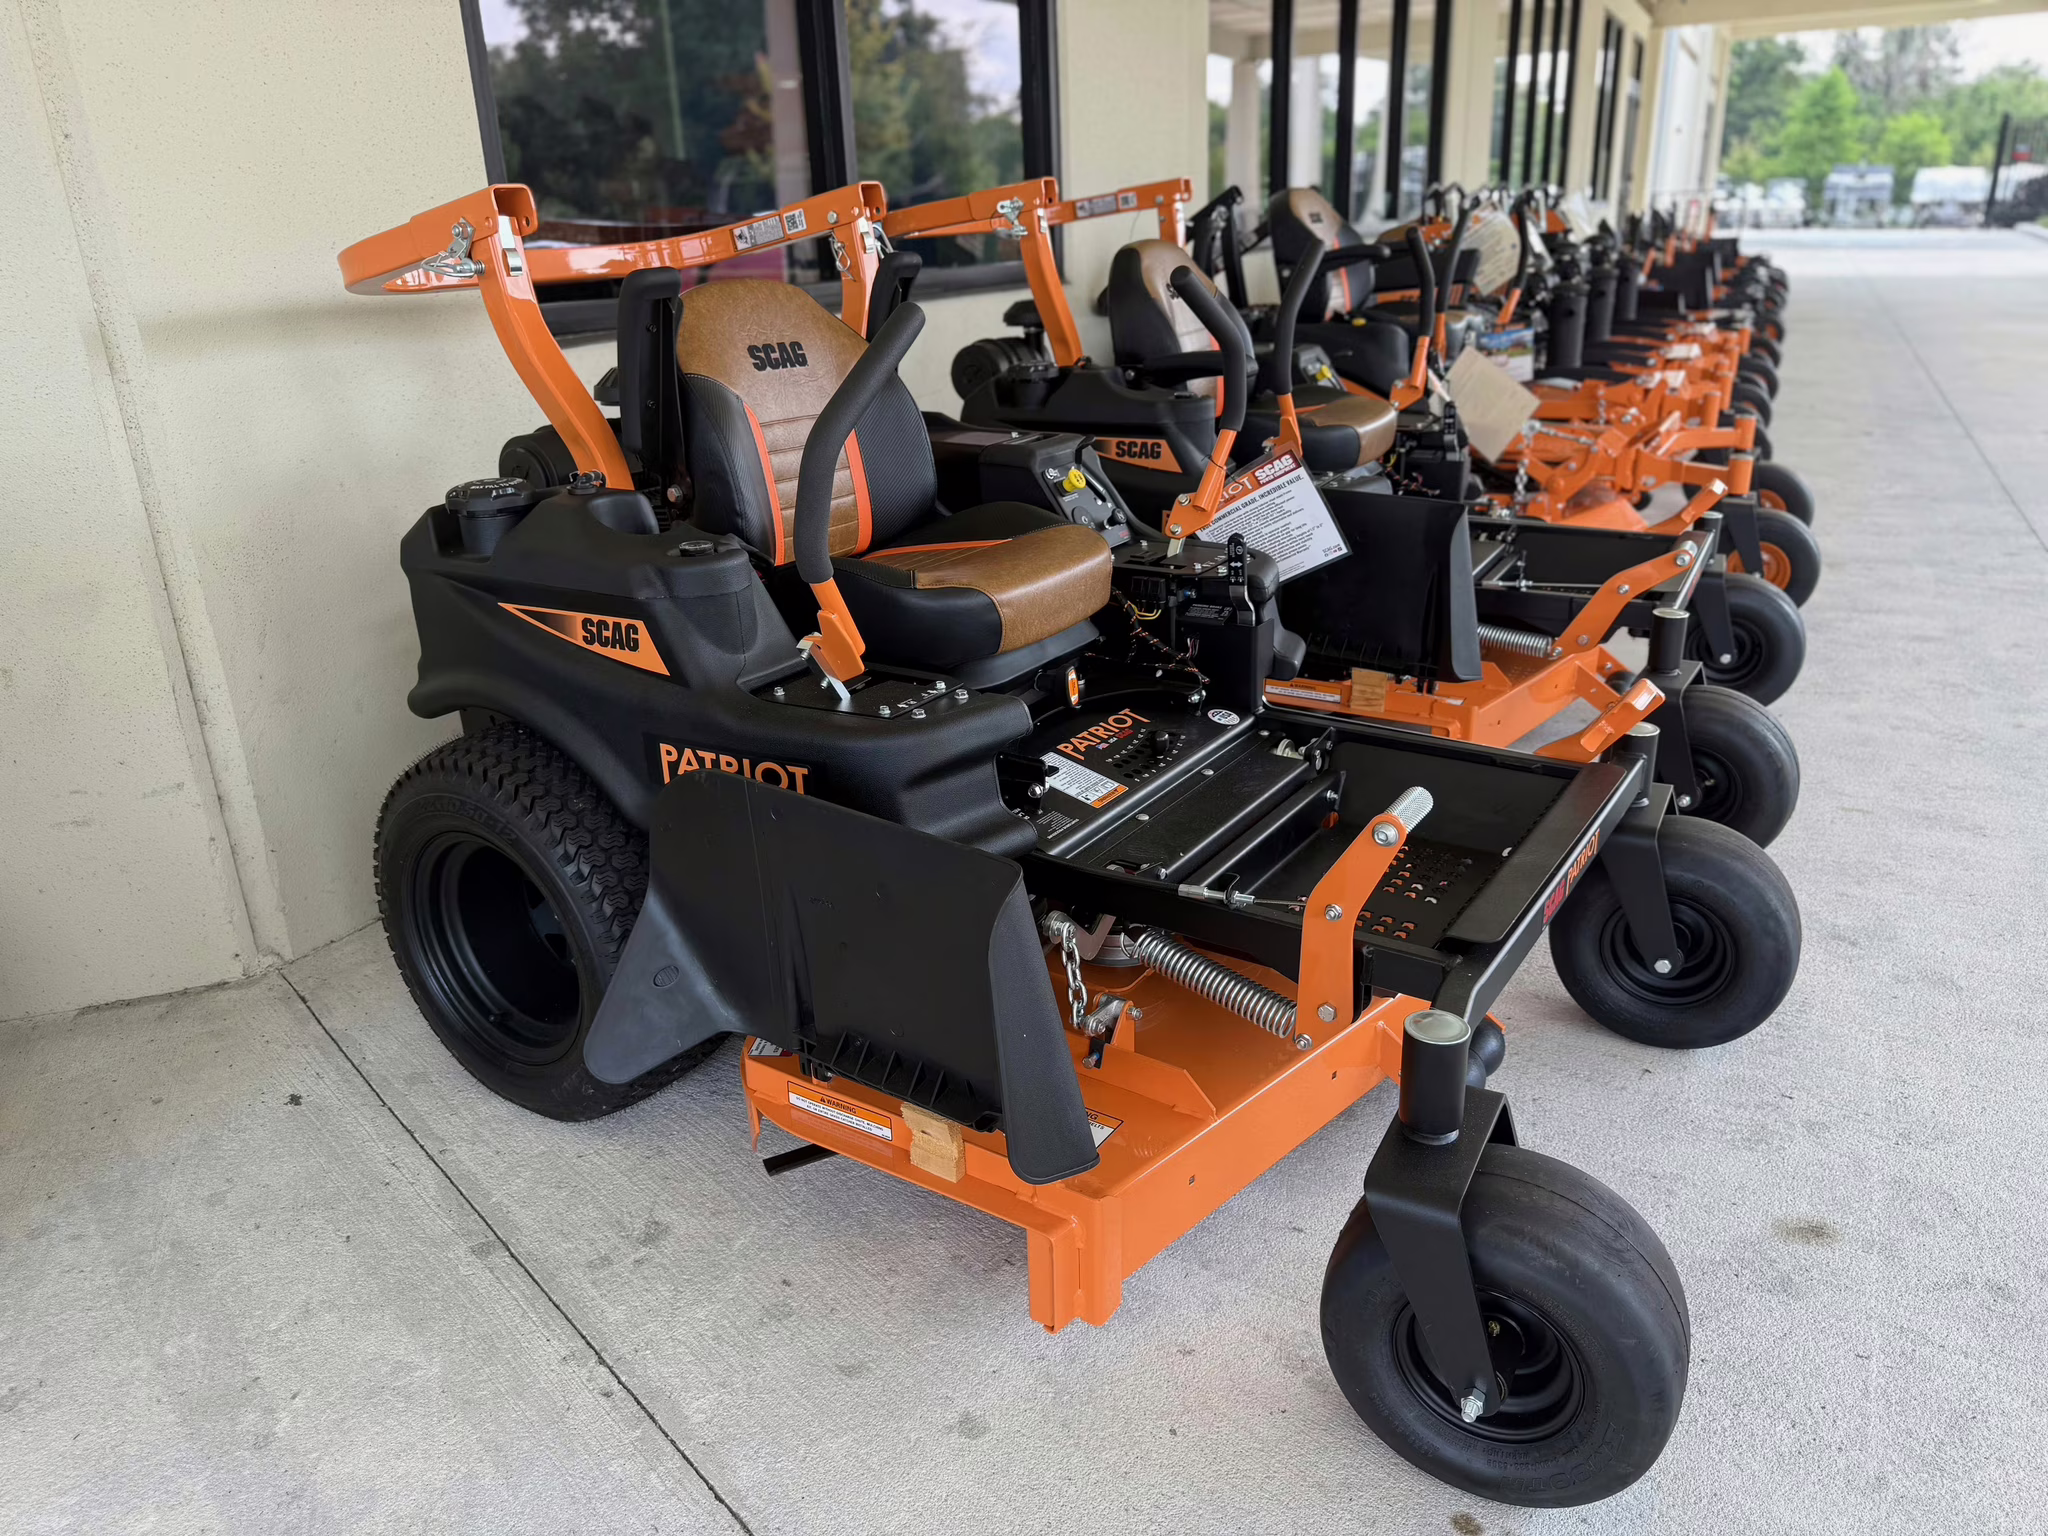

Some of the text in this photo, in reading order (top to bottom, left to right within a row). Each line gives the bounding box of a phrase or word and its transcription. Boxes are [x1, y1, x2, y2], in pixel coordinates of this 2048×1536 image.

[747, 341, 808, 372] SCAG
[1115, 441, 1162, 459] SCAG
[1254, 454, 1294, 480] SCAG
[1212, 504, 1242, 525] COMMERCIAL
[1240, 495, 1259, 509] GRADE.
[1258, 482, 1287, 500] INCREDIBLE
[1285, 474, 1304, 488] VALUE.
[582, 617, 639, 652] SCAG
[1056, 708, 1151, 760] PATRIOT
[1565, 828, 1600, 897] PATRIOT
[826, 1097, 857, 1114] WARNING
